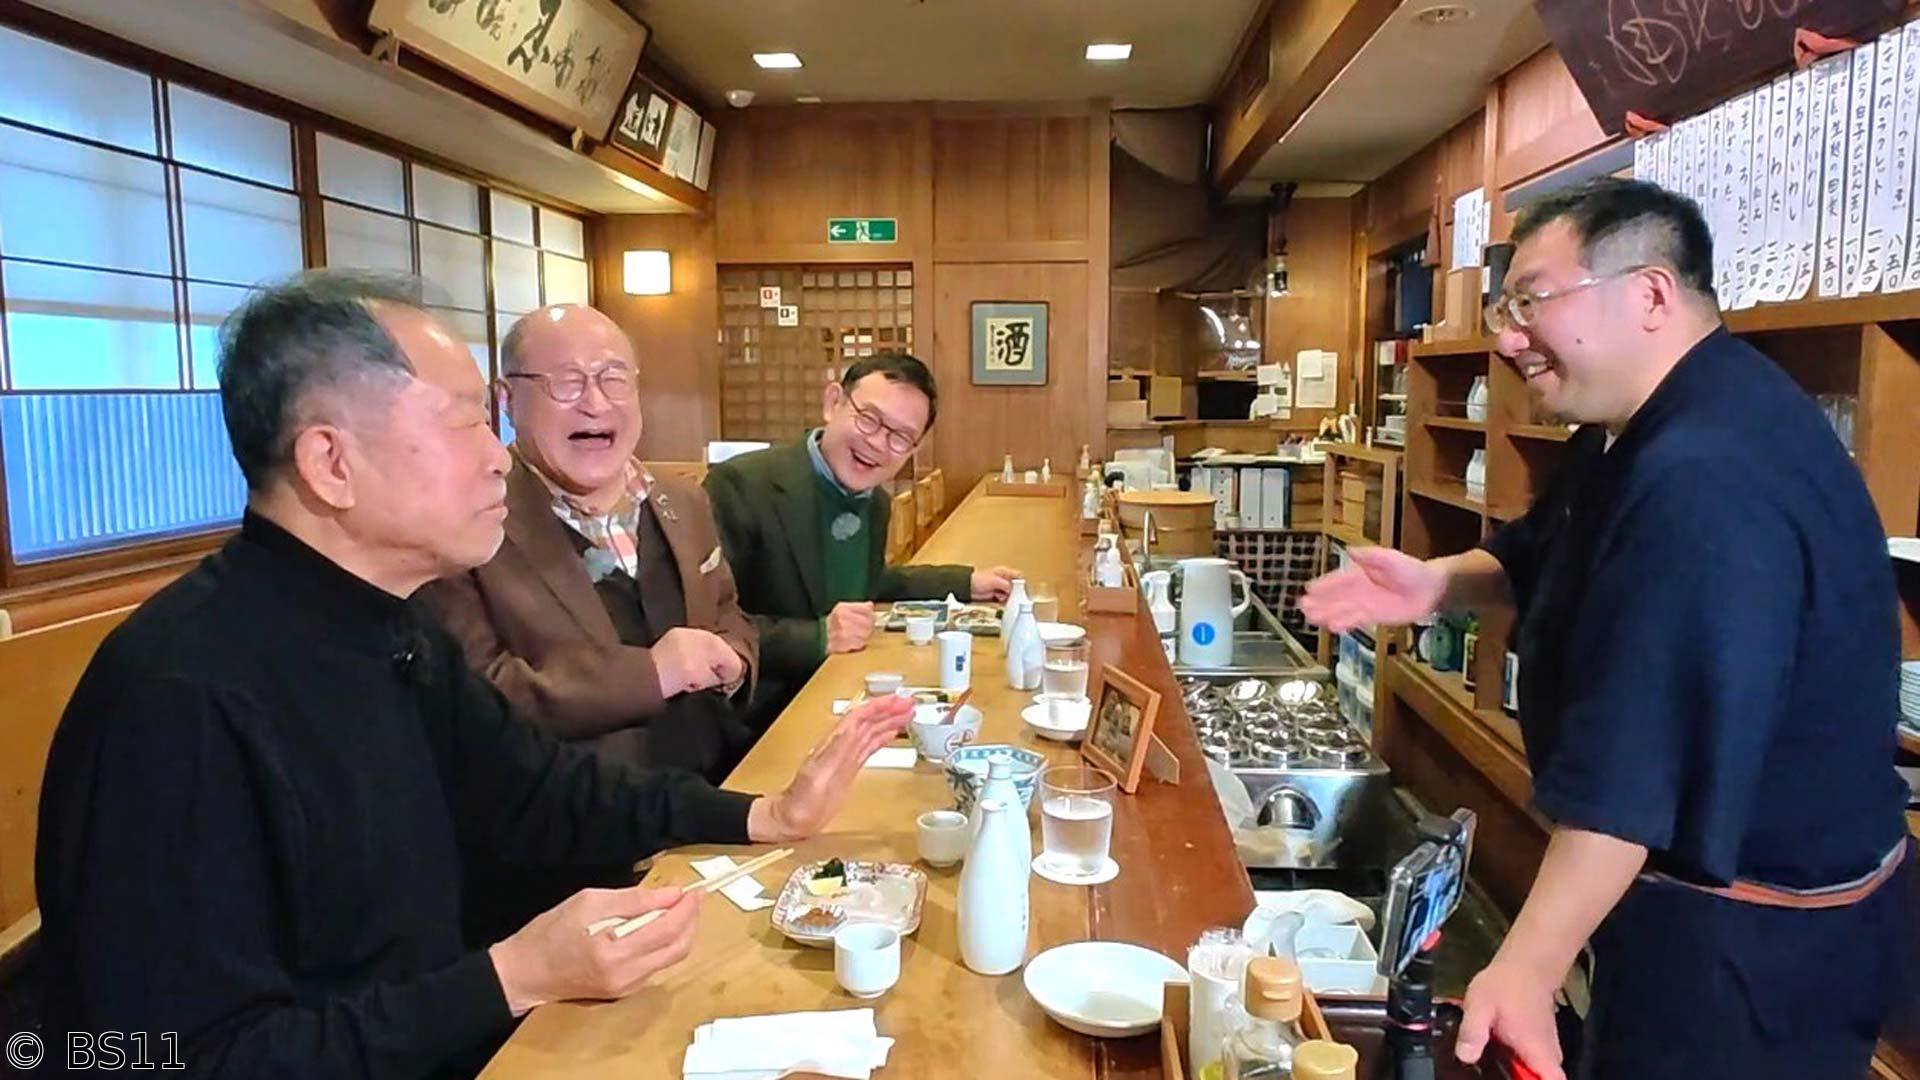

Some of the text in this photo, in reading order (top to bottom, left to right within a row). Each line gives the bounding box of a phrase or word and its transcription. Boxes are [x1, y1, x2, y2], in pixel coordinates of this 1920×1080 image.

[1770, 95, 1787, 212] このわた
[1789, 82, 1805, 221] うるめいわし
[996, 322, 1030, 366] 酒
